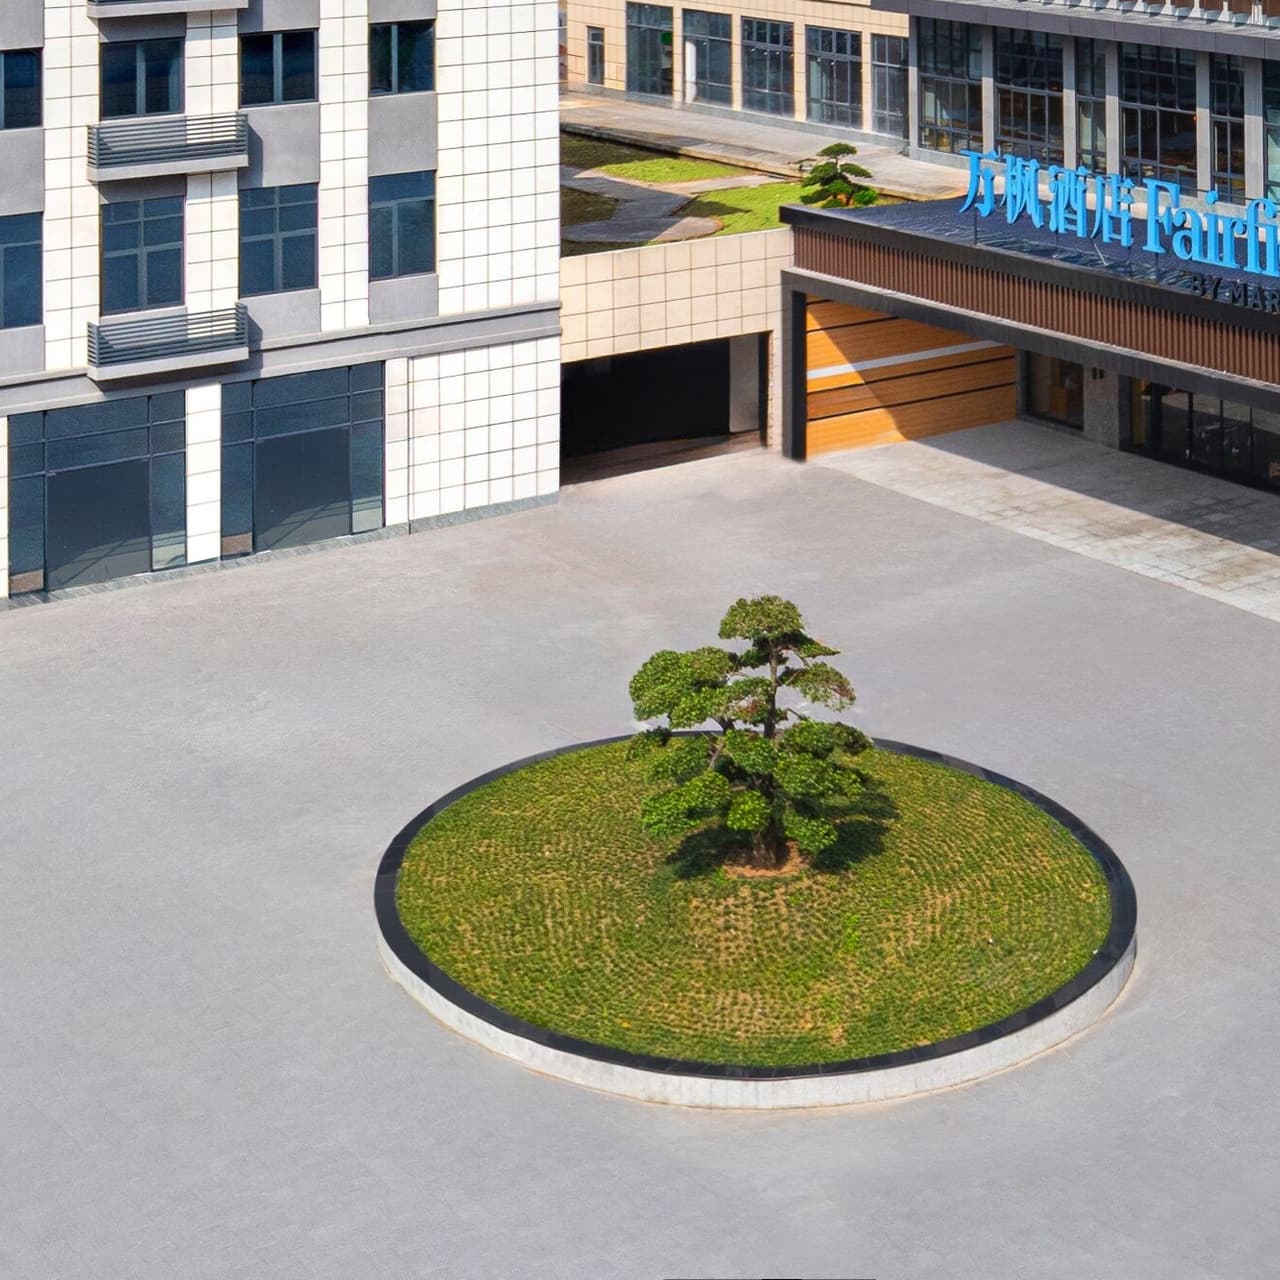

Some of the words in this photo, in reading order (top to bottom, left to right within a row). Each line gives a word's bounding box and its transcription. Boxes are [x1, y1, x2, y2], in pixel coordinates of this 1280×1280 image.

[959, 150, 1135, 247] 万枫酒店
[1189, 272, 1222, 299] BY
